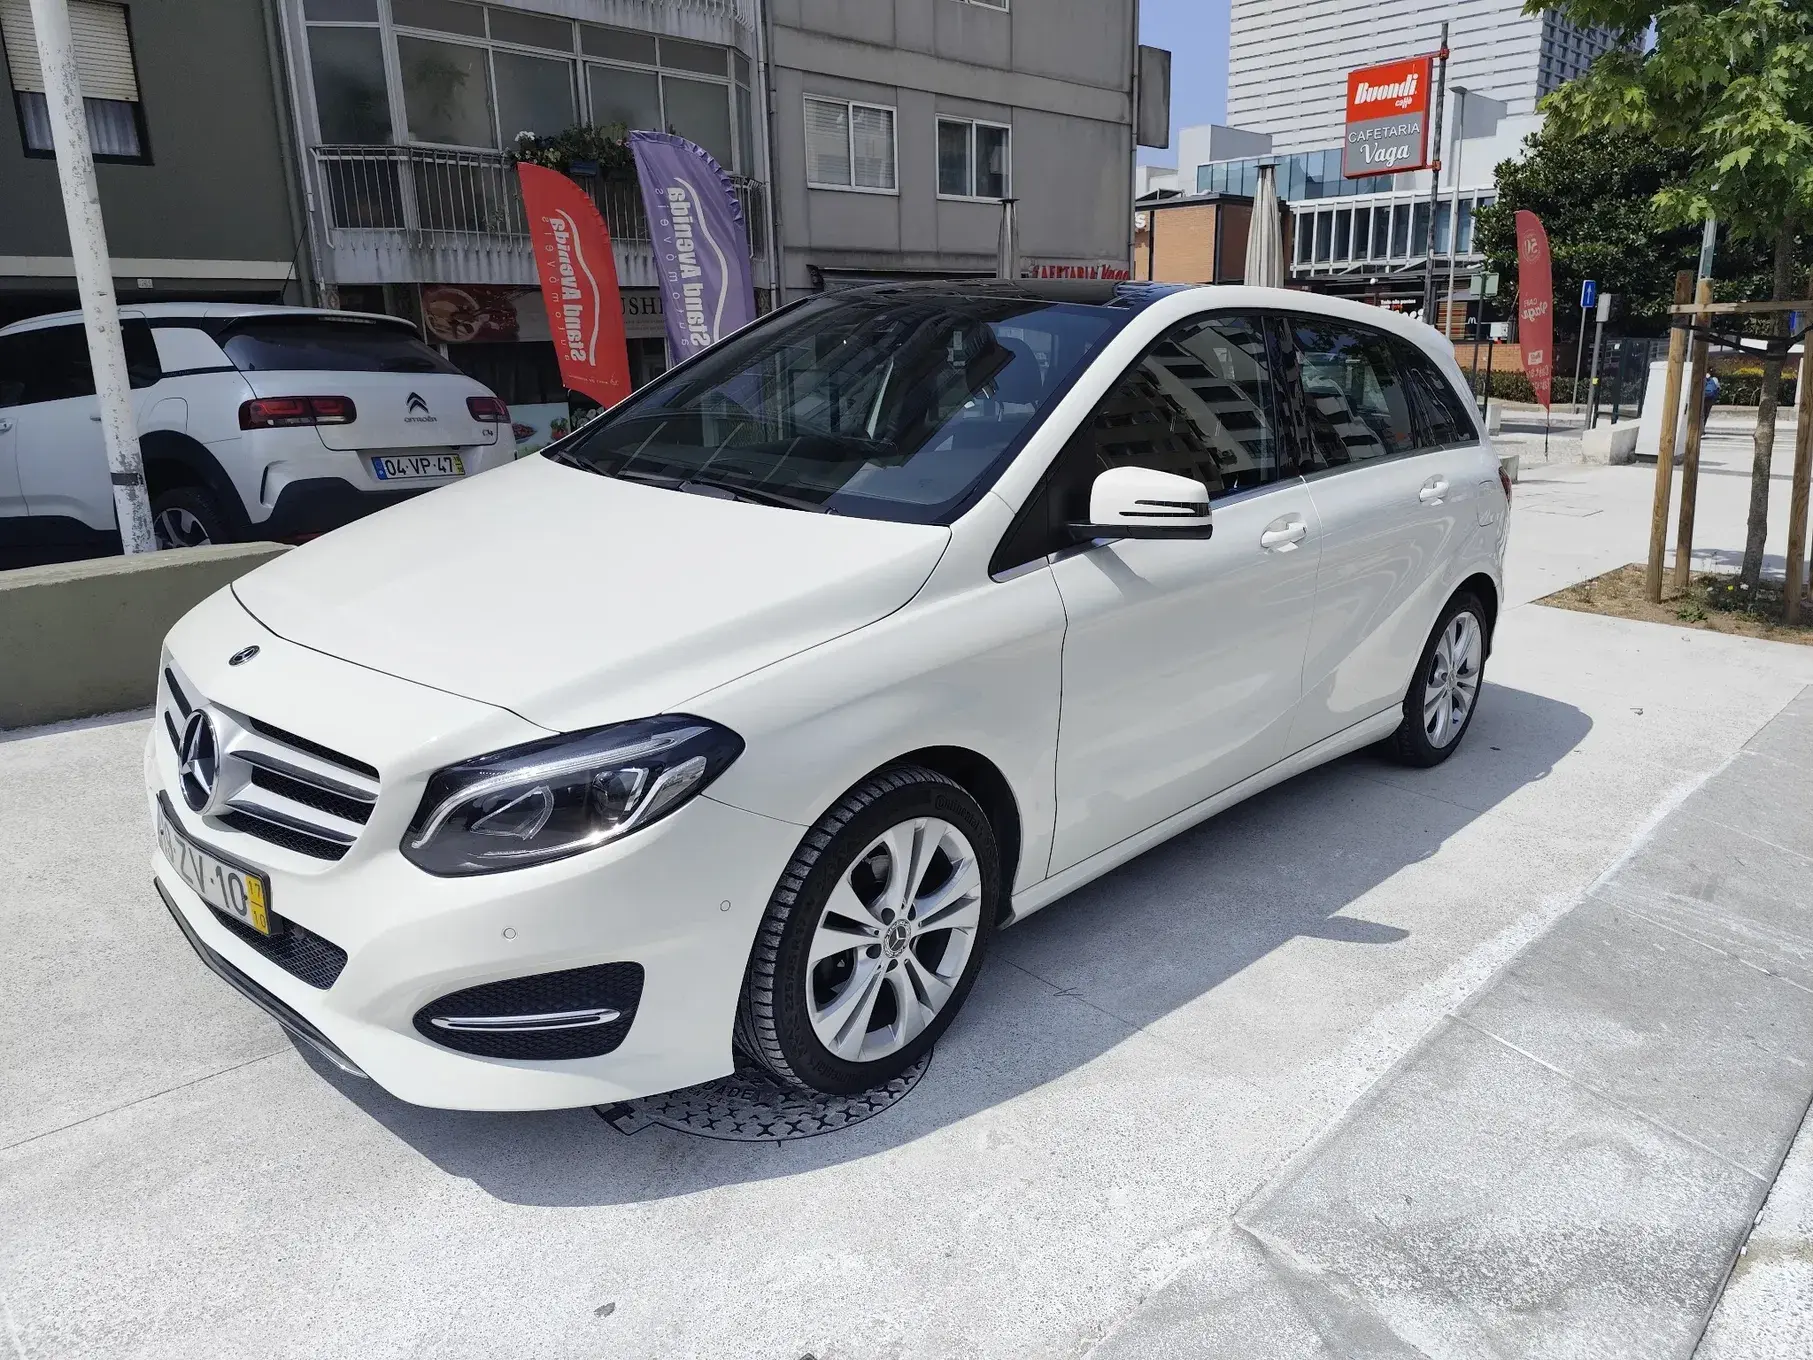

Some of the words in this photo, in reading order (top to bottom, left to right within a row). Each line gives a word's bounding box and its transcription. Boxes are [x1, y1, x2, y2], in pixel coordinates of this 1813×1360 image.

[1354, 73, 1419, 105] Buondi
[1348, 122, 1421, 143] CAFETARIA
[1360, 142, 1410, 167] Vaga
[248, 880, 261, 899] 17
[254, 910, 266, 929] 10
